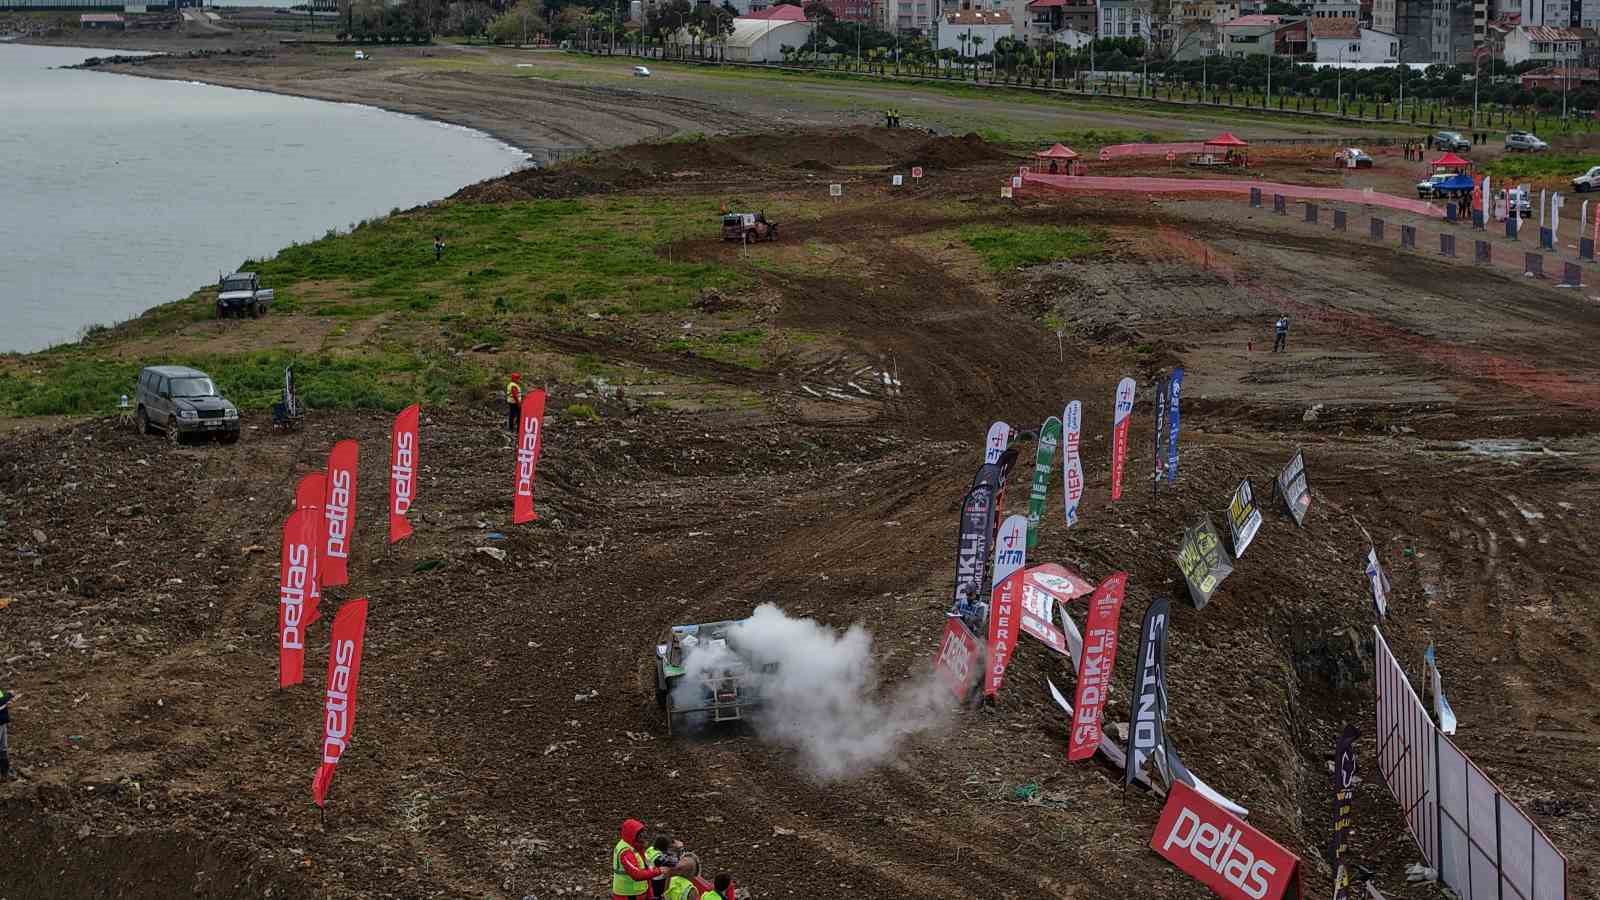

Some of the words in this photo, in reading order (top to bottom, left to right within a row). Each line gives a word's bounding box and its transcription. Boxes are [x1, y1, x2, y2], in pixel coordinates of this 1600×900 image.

[391, 431, 413, 515] petlas
[518, 417, 539, 496] petlas
[325, 469, 351, 559] petlas
[997, 550, 1024, 565] HTM
[281, 543, 309, 650] petlas
[992, 580, 1013, 687] JENERATOR
[323, 639, 355, 764] petlas
[1163, 807, 1277, 900] petlas
